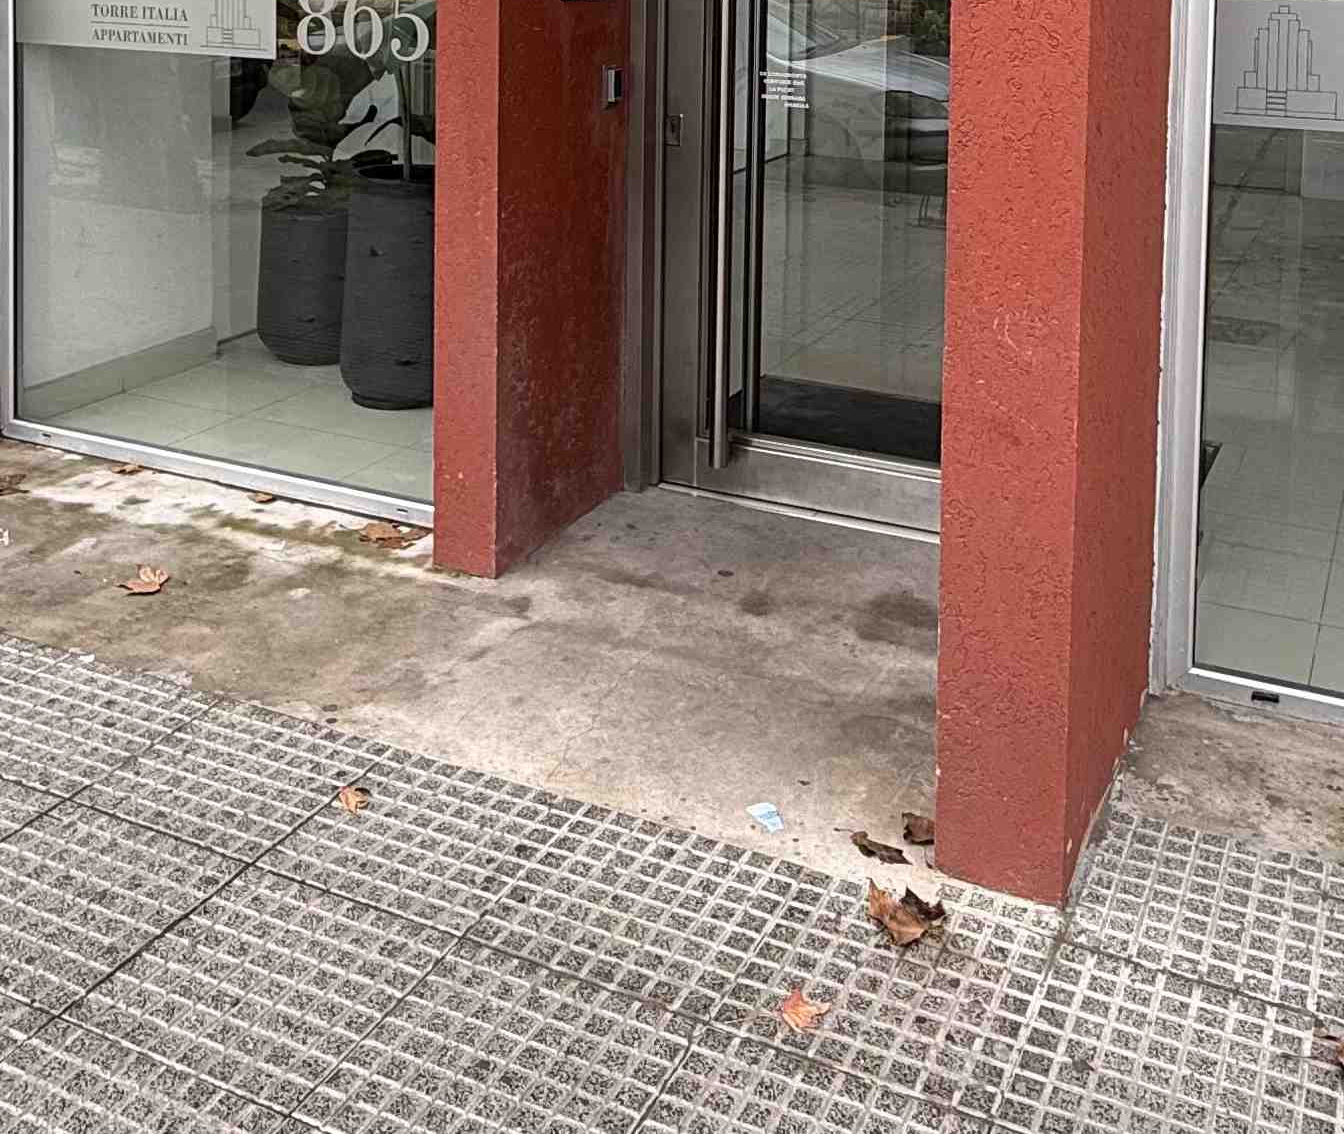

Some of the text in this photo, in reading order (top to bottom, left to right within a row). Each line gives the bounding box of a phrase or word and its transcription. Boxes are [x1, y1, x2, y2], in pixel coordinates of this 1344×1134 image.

[90, 3, 188, 22] TORRE ITALIA
[91, 28, 189, 46] APPARTAMENTI
